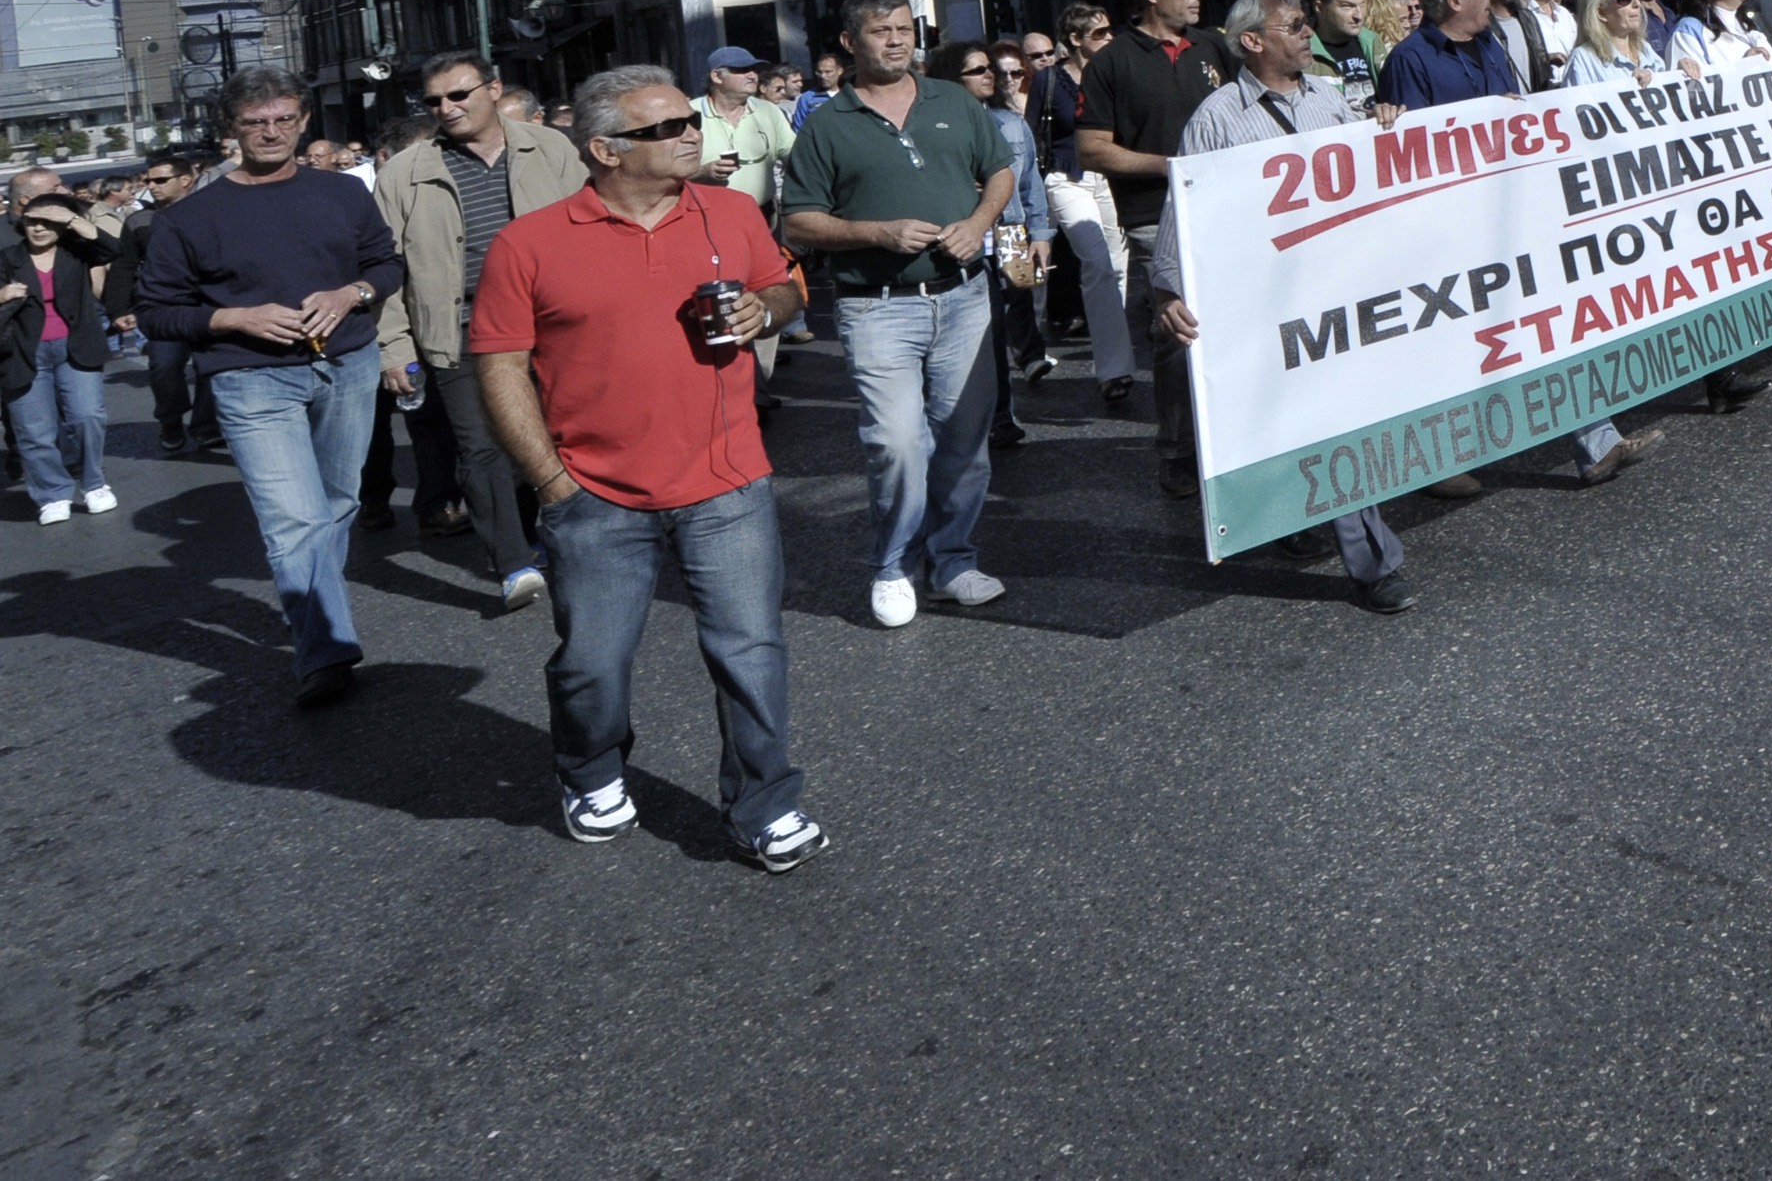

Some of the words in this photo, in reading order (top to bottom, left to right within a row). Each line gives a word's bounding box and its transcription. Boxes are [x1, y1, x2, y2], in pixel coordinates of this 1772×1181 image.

[1262, 143, 1356, 216] 20
[1373, 108, 1570, 189] Μήνες
[1618, 74, 1739, 130] ΕΡΓΑΖ.
[1558, 123, 1771, 216] ΕΙΜΑΣΤΕ
[1278, 253, 1538, 371] ΜΕΧΡΙ
[1559, 209, 1677, 284] ΠΟΥ
[1697, 188, 1763, 236] ΘΑ
[1298, 392, 1514, 518] ΣΩΜΑΤΕΙΟ
[1521, 305, 1743, 437] ΕΡΓΑΖΟΜΕΝΩΝ
